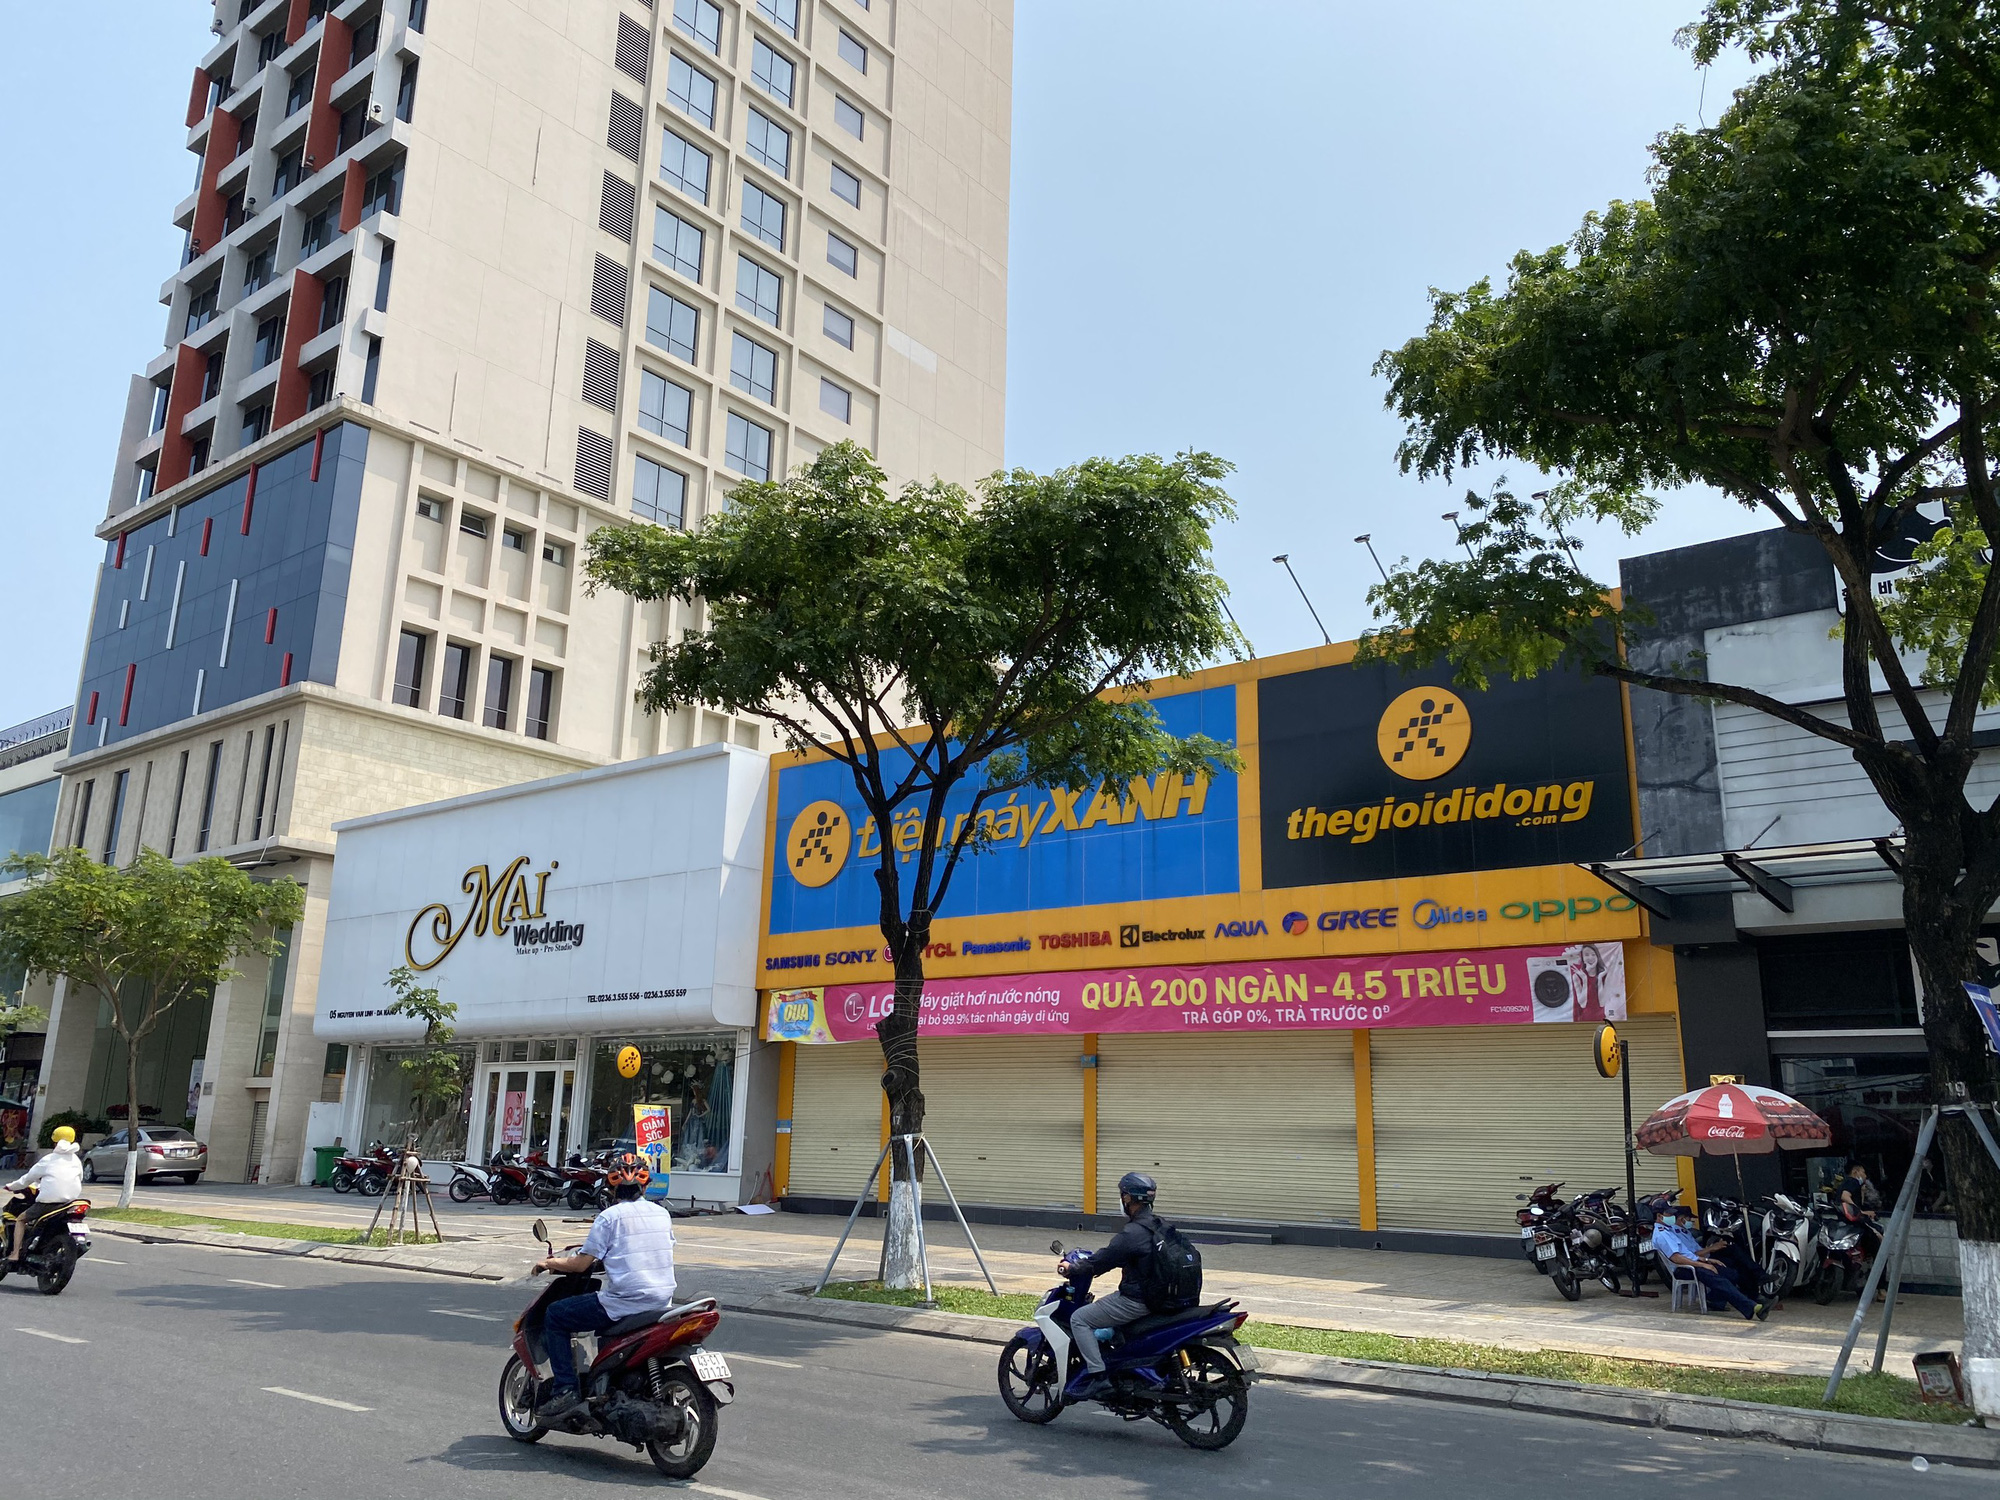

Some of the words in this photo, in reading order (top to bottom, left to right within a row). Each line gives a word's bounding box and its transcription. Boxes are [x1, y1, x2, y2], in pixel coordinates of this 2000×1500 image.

[1287, 781, 1594, 844] thegioididong
[1516, 813, 1557, 828] .com
[1317, 907, 1399, 931] GREE
[1413, 899, 1487, 929] Midea
[513, 920, 585, 947] Wedding
[1142, 928, 1205, 943] Electrolux
[1214, 920, 1268, 938] AQUA
[925, 942, 956, 958] TCL
[962, 937, 1031, 956] Panasonic
[1039, 931, 1112, 950] TOSHIBA
[766, 954, 820, 970] SAMSUNG
[1081, 974, 1144, 1010] QUÀ
[1150, 978, 1207, 1007] 200
[1215, 968, 1309, 1004] NGÀN
[1332, 970, 1387, 1000] 4.5
[1392, 957, 1507, 1004] TRIỆU
[868, 994, 894, 1018] LG
[989, 988, 1023, 1005] nước
[1024, 987, 1060, 1009] nóng
[329, 1009, 337, 1019] 05
[942, 1012, 970, 1025] 99.9%
[970, 1011, 986, 1024] tác
[986, 1010, 1012, 1024] nhân
[1013, 1009, 1034, 1026] gây
[1212, 1007, 1243, 1024] GÓP
[1310, 1003, 1368, 1022] TRƯỚC
